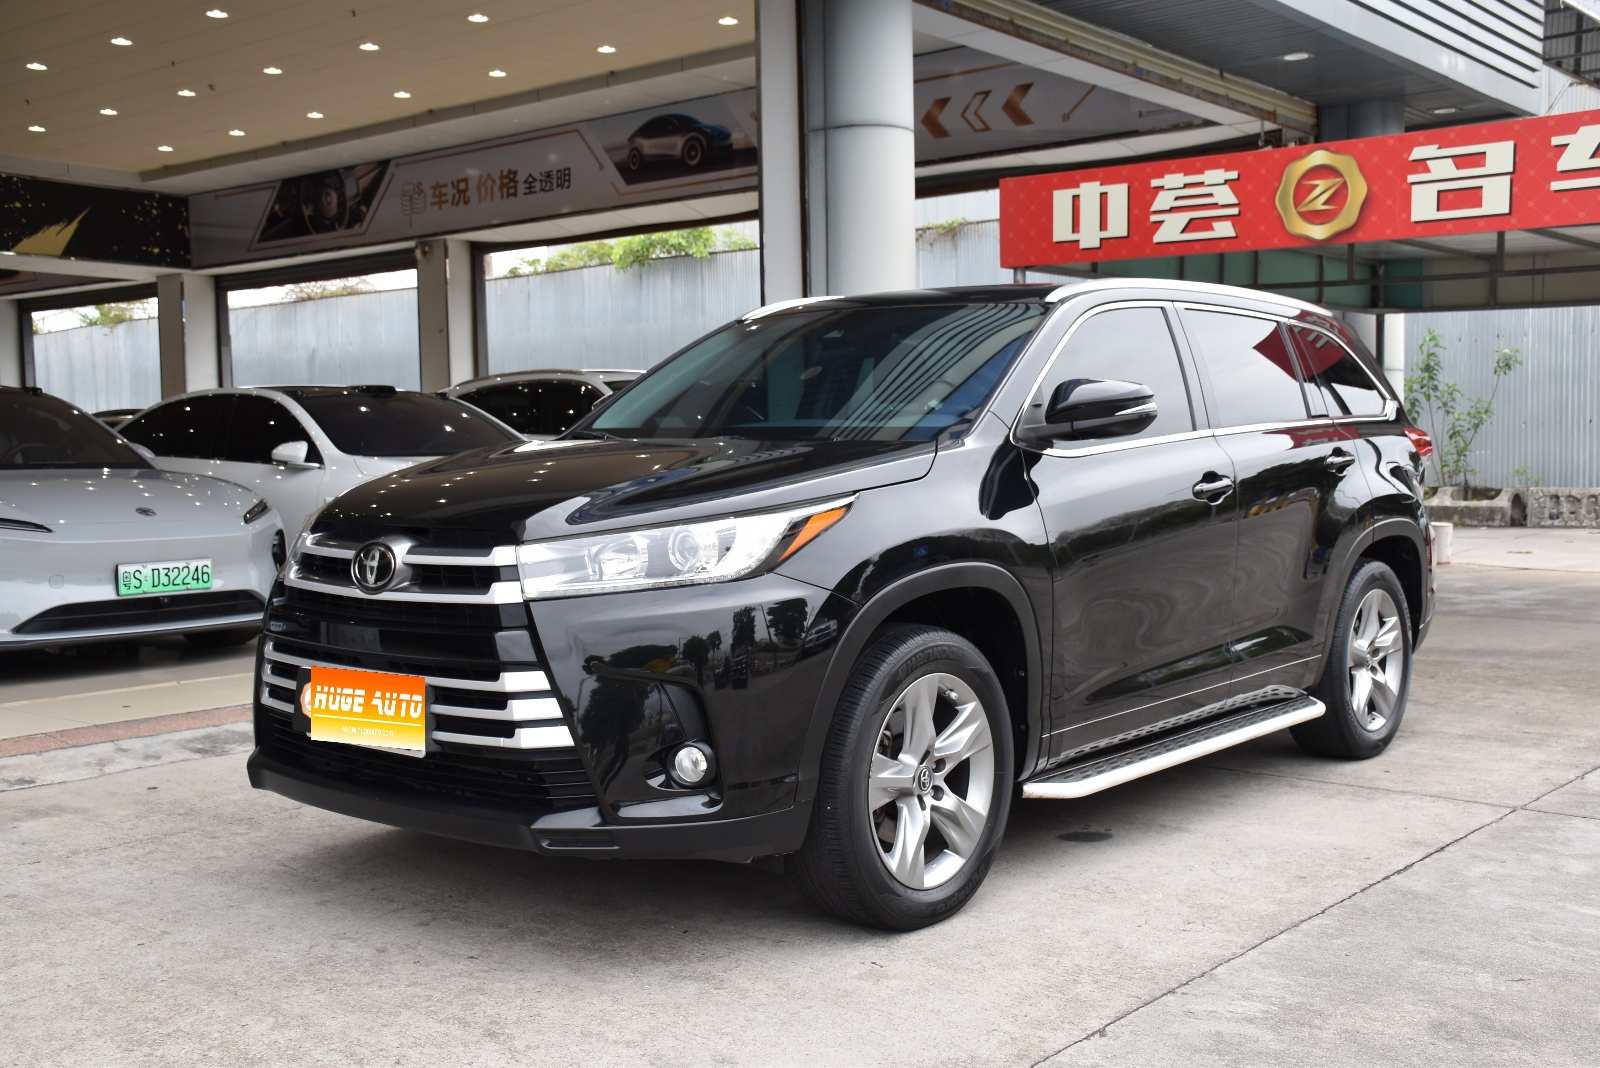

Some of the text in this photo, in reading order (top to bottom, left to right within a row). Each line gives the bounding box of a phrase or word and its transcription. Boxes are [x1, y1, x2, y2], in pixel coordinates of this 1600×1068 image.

[430, 167, 571, 210] 车况 价格 全透明
[1052, 168, 1240, 251] 中荟
